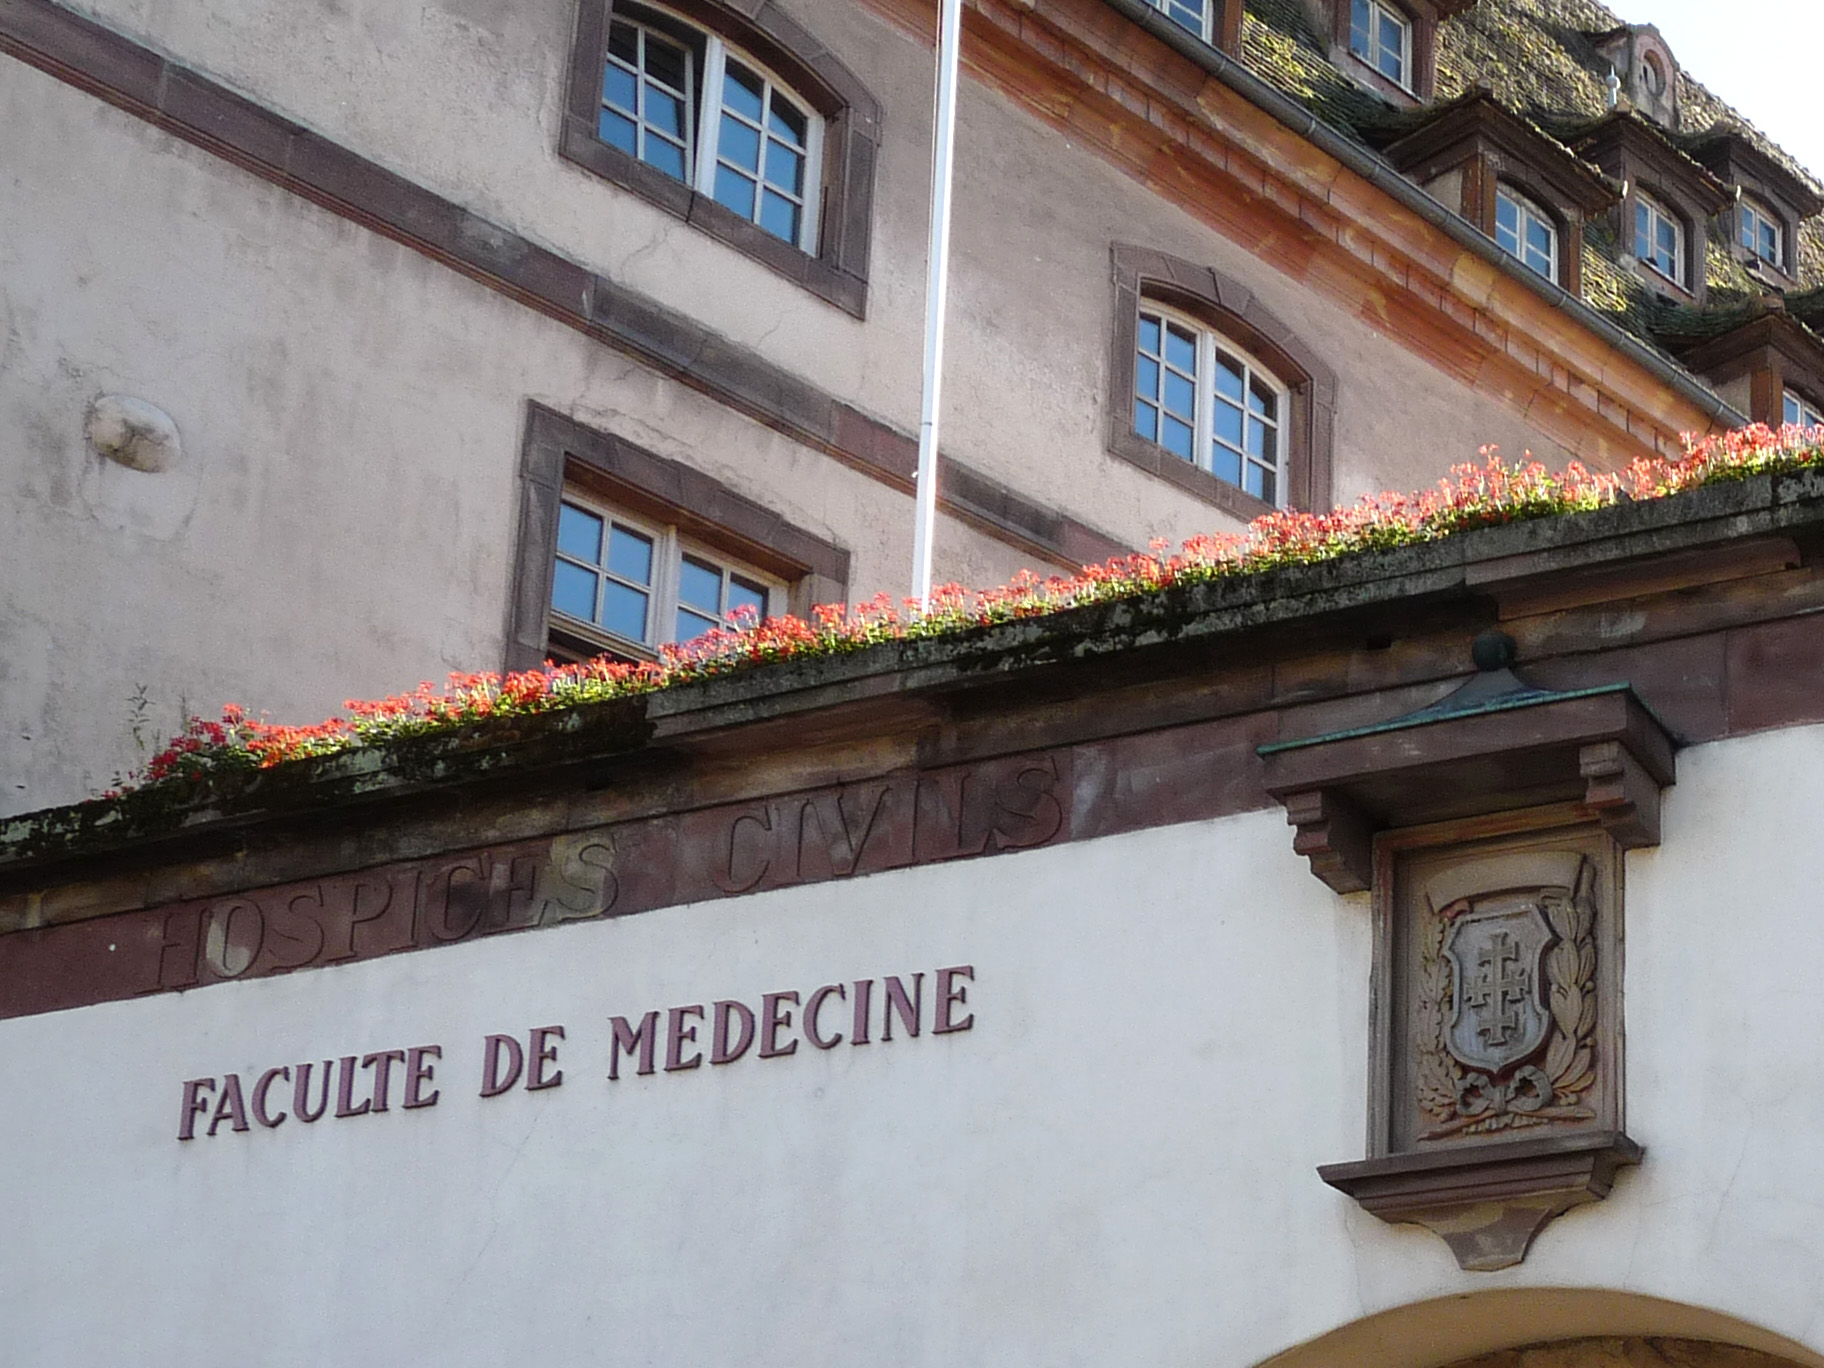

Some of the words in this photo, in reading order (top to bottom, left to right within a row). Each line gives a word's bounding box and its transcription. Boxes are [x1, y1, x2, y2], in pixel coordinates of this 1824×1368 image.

[134, 835, 621, 994] HOSPICES
[711, 755, 1063, 894] CIVILS
[176, 1045, 442, 1142] FACULTE
[479, 1025, 566, 1099] DE
[607, 965, 976, 1081] MEDECINE
